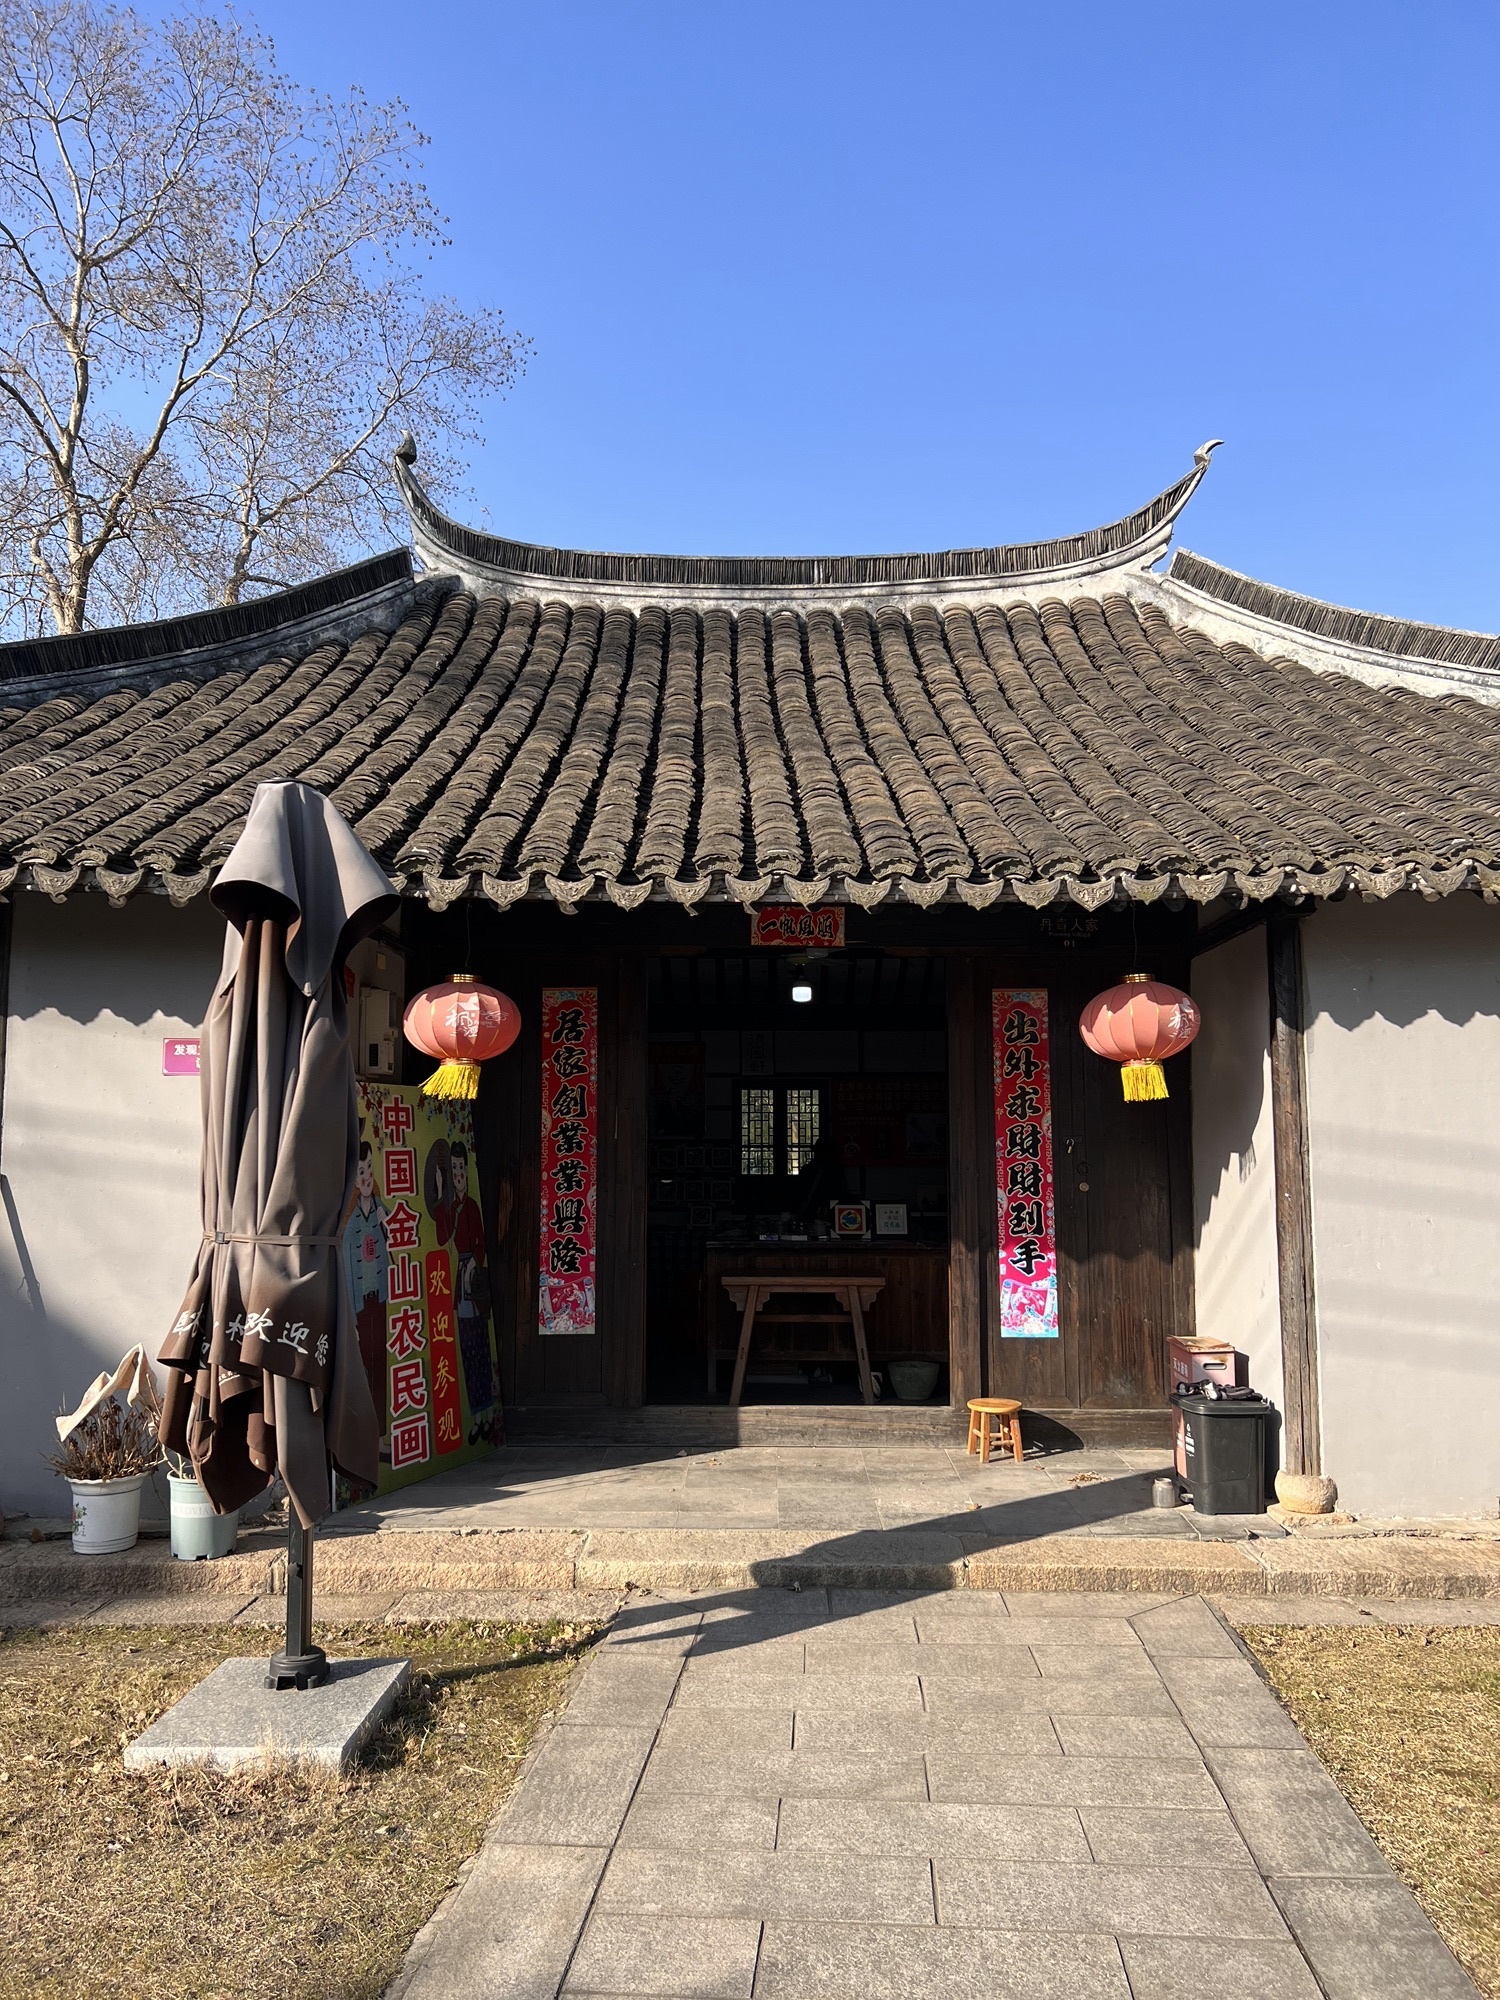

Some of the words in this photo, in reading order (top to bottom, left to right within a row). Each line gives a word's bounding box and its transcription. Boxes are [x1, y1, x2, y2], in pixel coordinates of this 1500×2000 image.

[760, 913, 835, 939] 一帆風順
[1040, 918, 1099, 931] 丹青人家
[1064, 939, 1076, 947] 01
[174, 1044, 200, 1055] 发现
[551, 1009, 588, 1275] 居家創業業興隆
[1002, 1010, 1046, 1276] 出外求財財到手
[382, 1097, 430, 1470] 中国金山农民画
[430, 1260, 460, 1442] 欢迎参观
